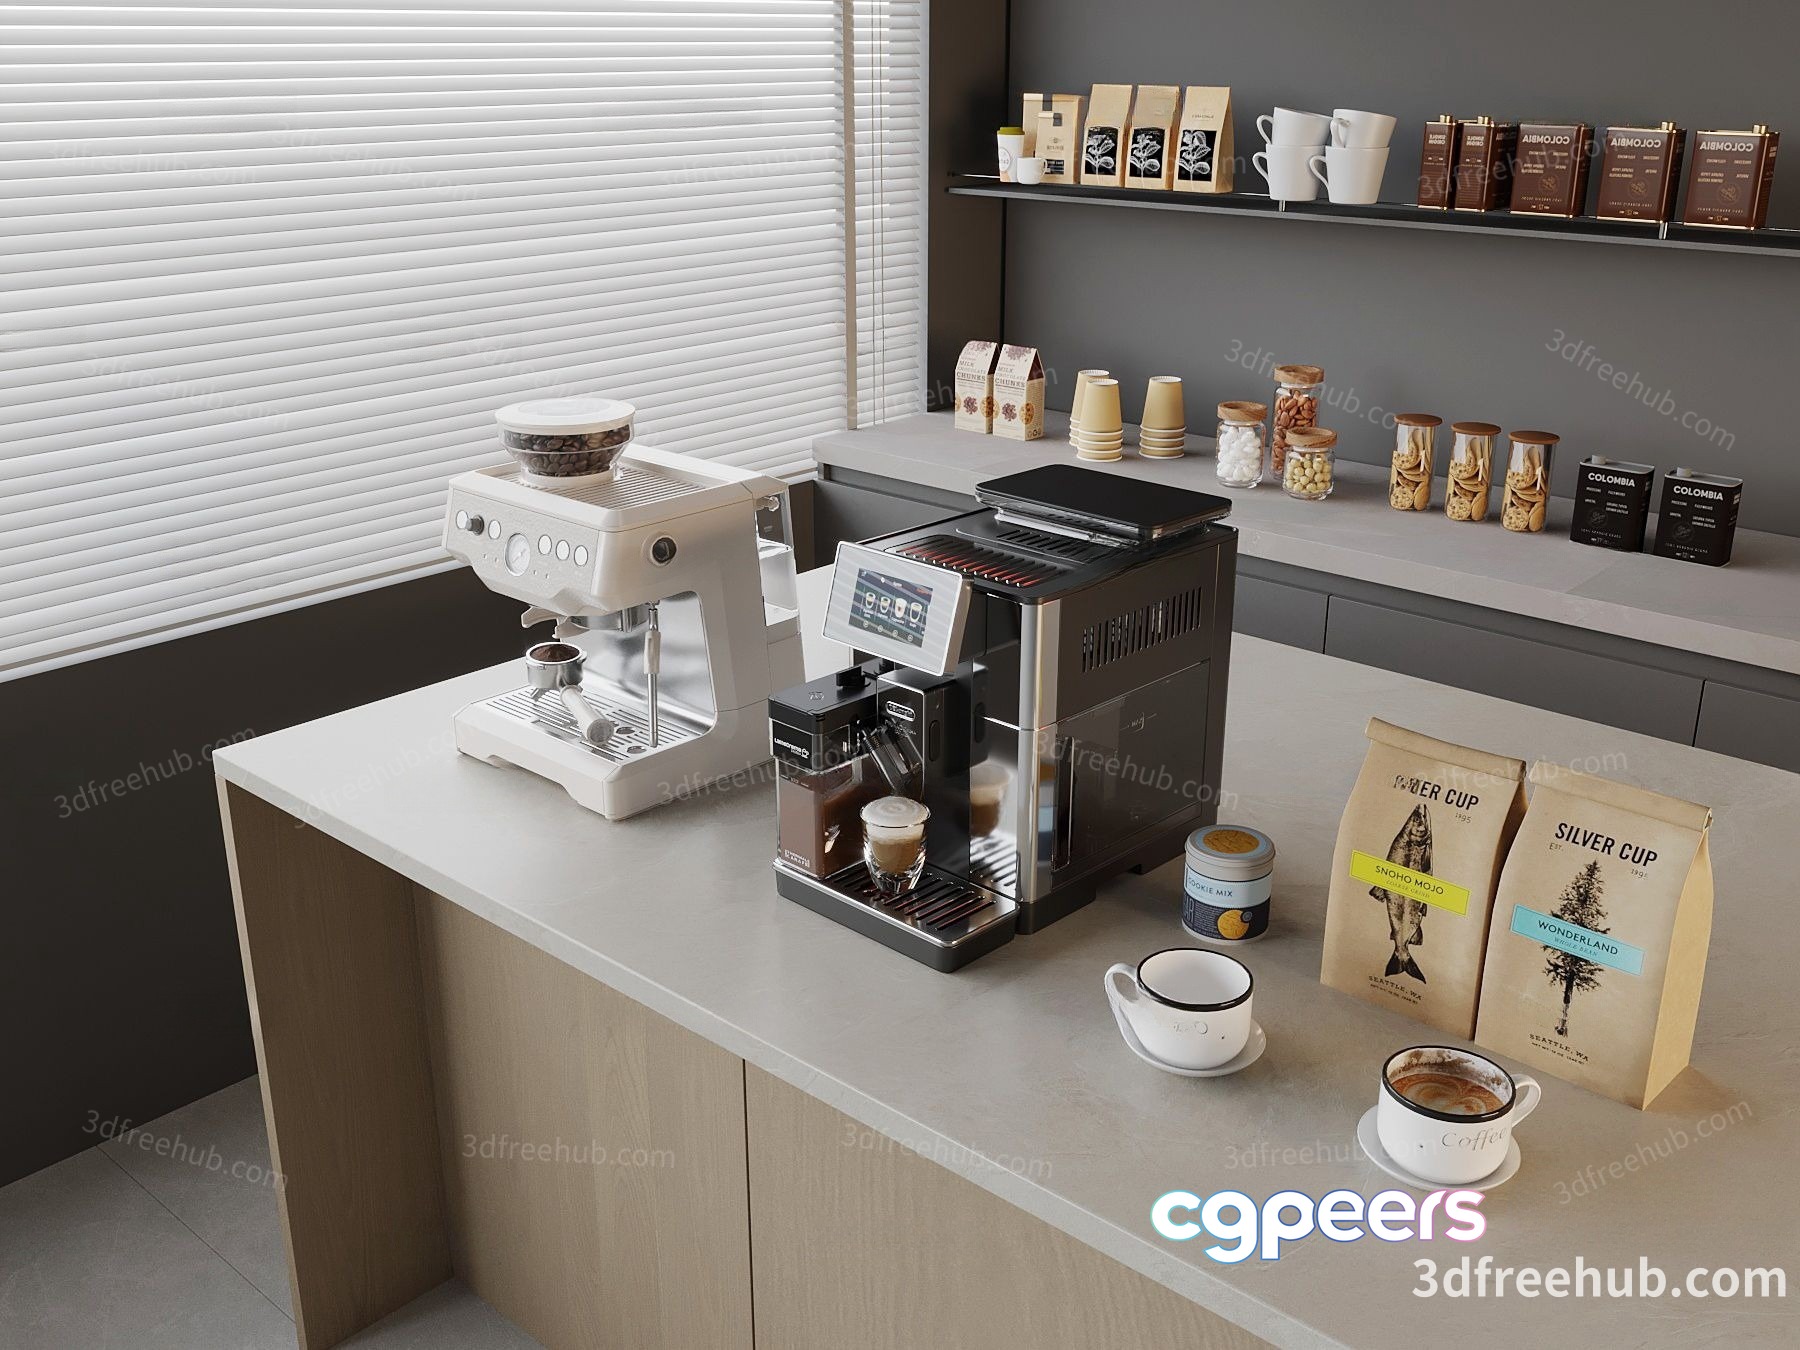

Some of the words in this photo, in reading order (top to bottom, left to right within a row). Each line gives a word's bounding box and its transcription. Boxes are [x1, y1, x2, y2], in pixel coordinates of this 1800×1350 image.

[956, 371, 986, 381] CHUNKS
[1588, 472, 1636, 488] COLOMBIA
[1673, 485, 1724, 501] COLOMBIA
[1444, 788, 1480, 811] CUP
[1554, 822, 1616, 856] SILVER
[1618, 842, 1658, 867] CUP
[1375, 865, 1412, 884] SNOHO
[1414, 878, 1445, 895] MOJO
[1215, 889, 1233, 898] MIX
[1538, 919, 1619, 956] WONDERLAND
[1576, 1050, 1589, 1062] WA
[1441, 1127, 1508, 1151] Coffee
